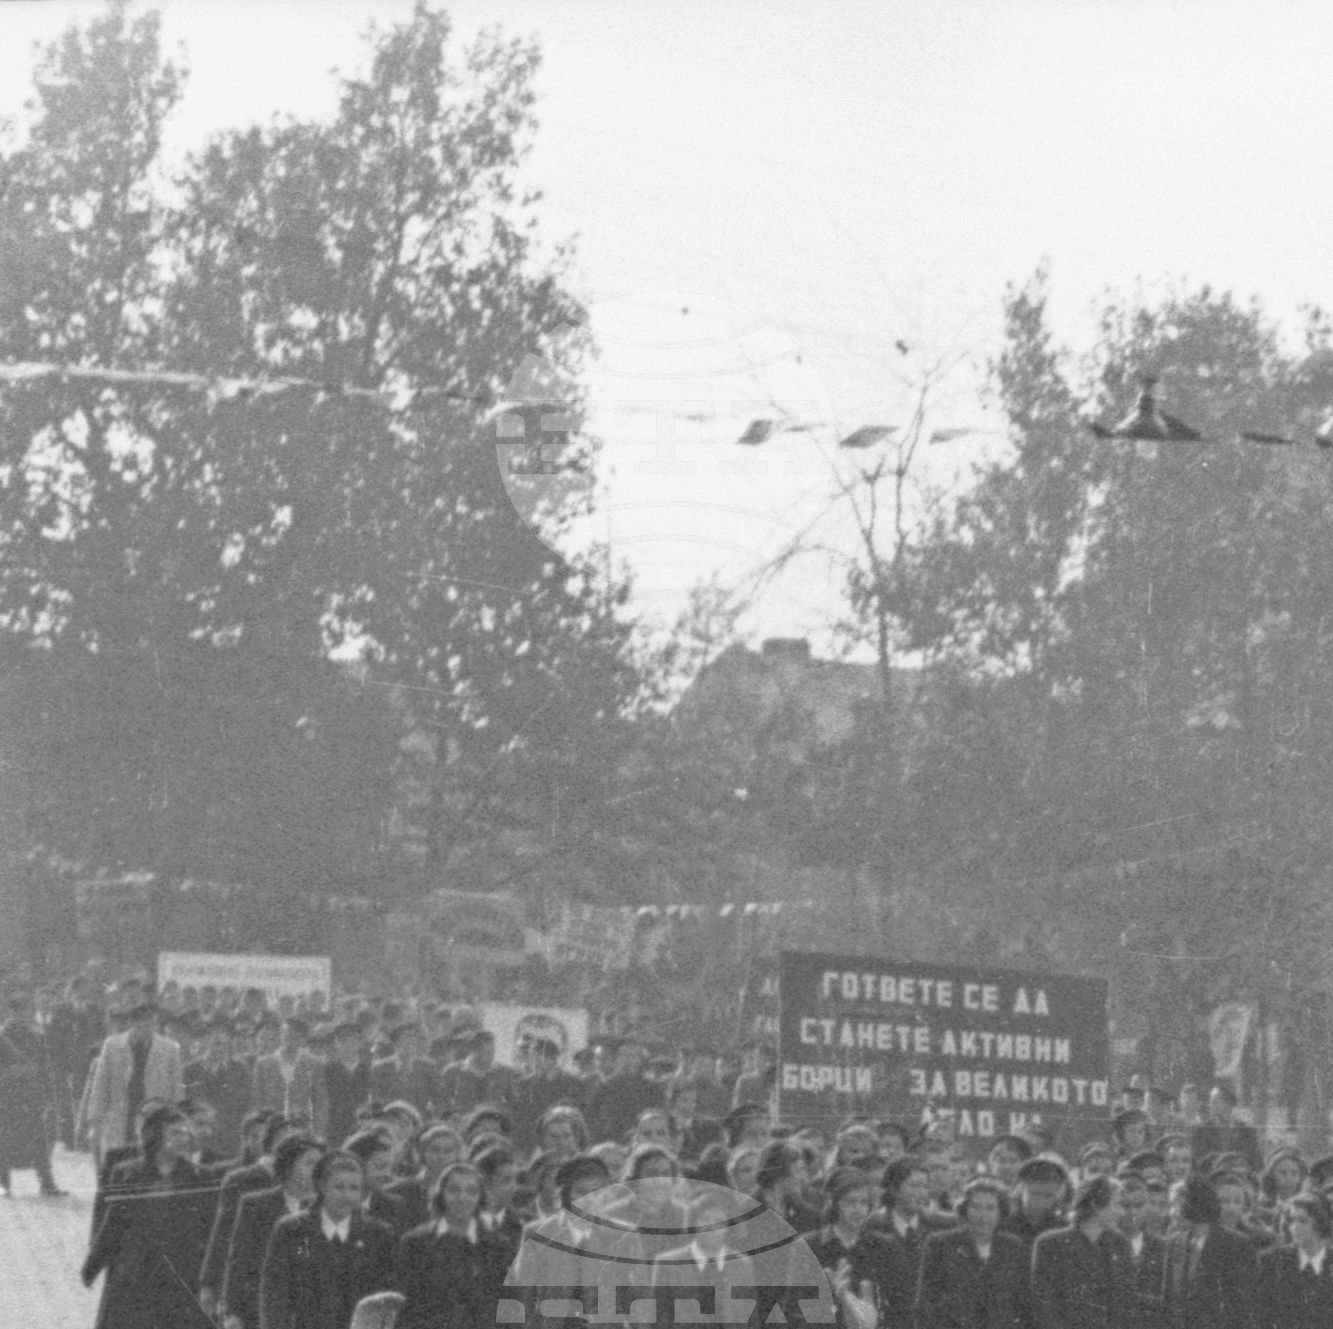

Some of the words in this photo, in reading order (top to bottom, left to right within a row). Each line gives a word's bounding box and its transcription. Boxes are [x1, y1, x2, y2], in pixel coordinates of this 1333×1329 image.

[821, 970, 952, 1008] ГОТВЕТЕ
[963, 982, 999, 1012] СЕ
[800, 1016, 931, 1053] СТАНЕТЕ
[941, 1028, 1070, 1064] АКТИВНИ
[782, 1062, 873, 1094] БОРЦИ
[909, 1068, 948, 1098] ЗА
[953, 1070, 1109, 1106] ВЕЛИКОТО
